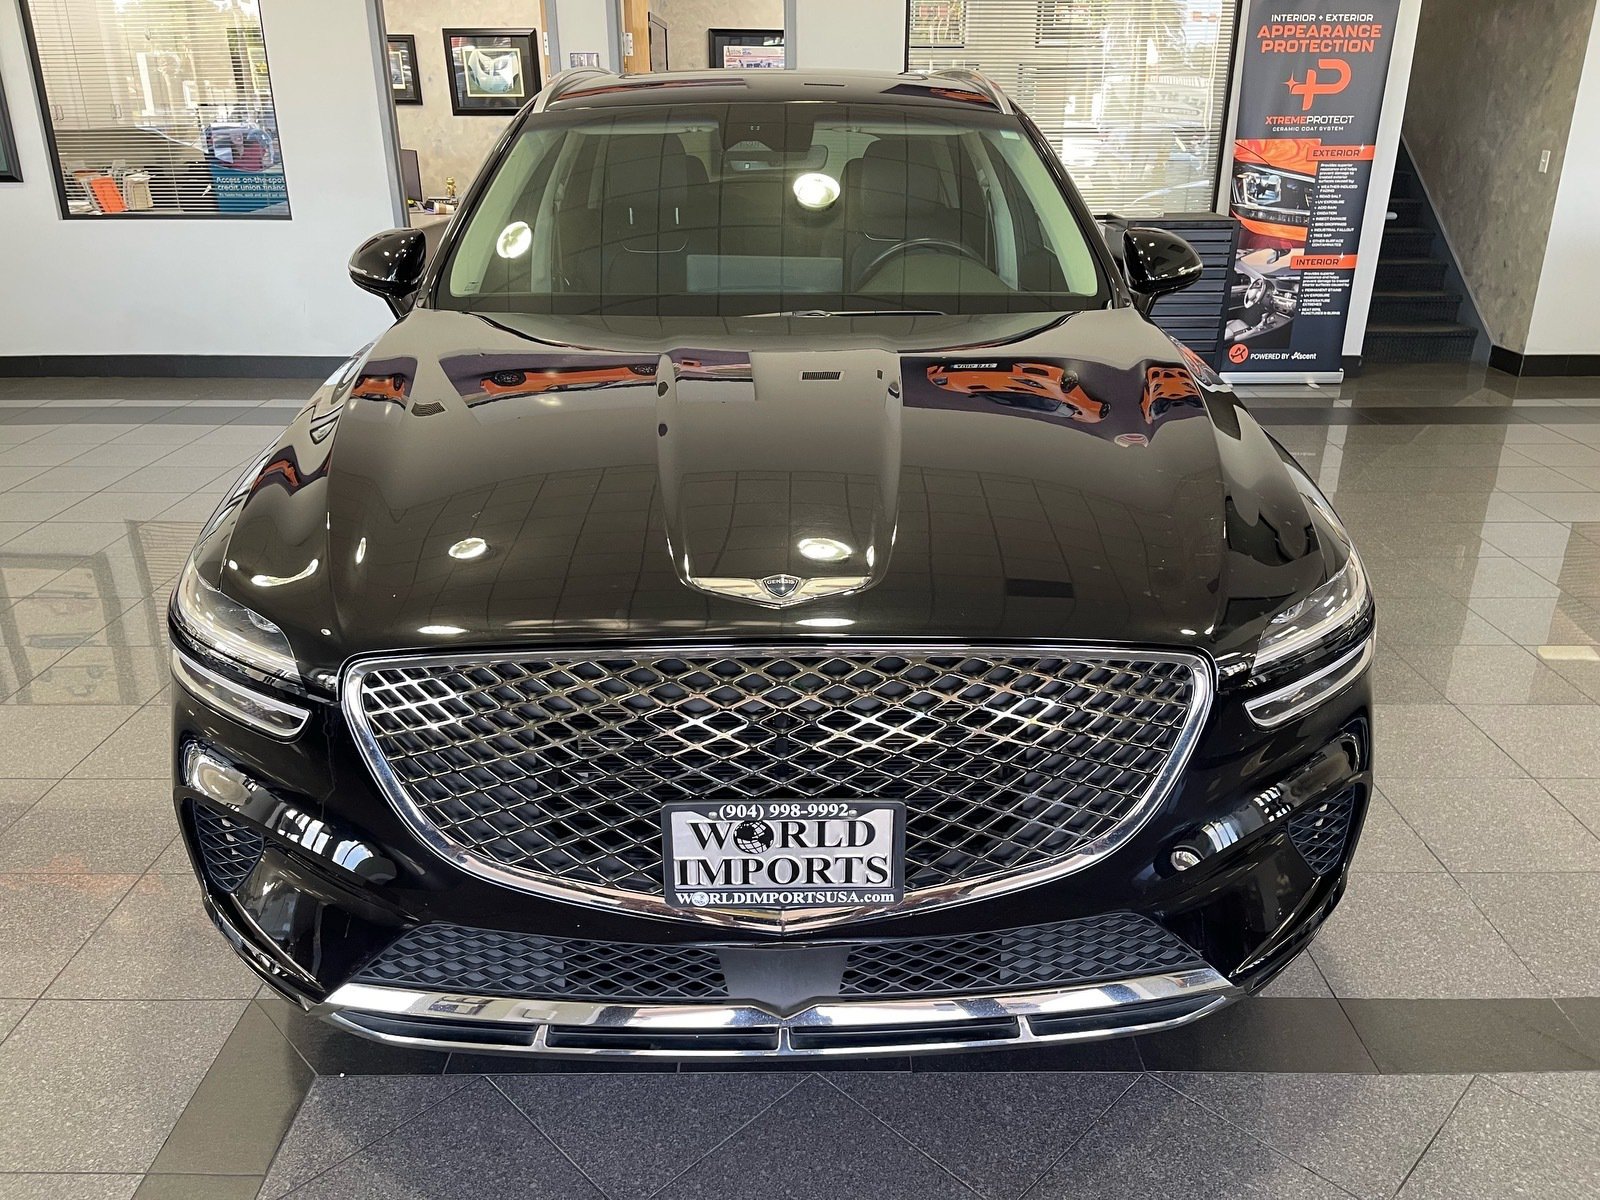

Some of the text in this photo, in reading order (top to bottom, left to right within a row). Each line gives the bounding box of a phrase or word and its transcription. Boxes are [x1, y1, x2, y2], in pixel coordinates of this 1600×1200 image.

[1271, 14, 1316, 22] INTERIOR
[1325, 14, 1374, 22] EXTERIOR
[1257, 24, 1382, 38] APPEARANCE
[1261, 39, 1375, 53] PROTECTION
[1265, 115, 1354, 125] XTREMEPROTECT
[1312, 149, 1360, 157] EXTERIOR
[216, 176, 241, 184] Access
[1296, 258, 1339, 266] INTERIOR
[719, 803, 849, 820] (904) 998-9992
[688, 819, 876, 854] WORLD
[674, 855, 889, 886] IMPORTS
[675, 890, 895, 907] WORLDIMPORTSUSA.com
